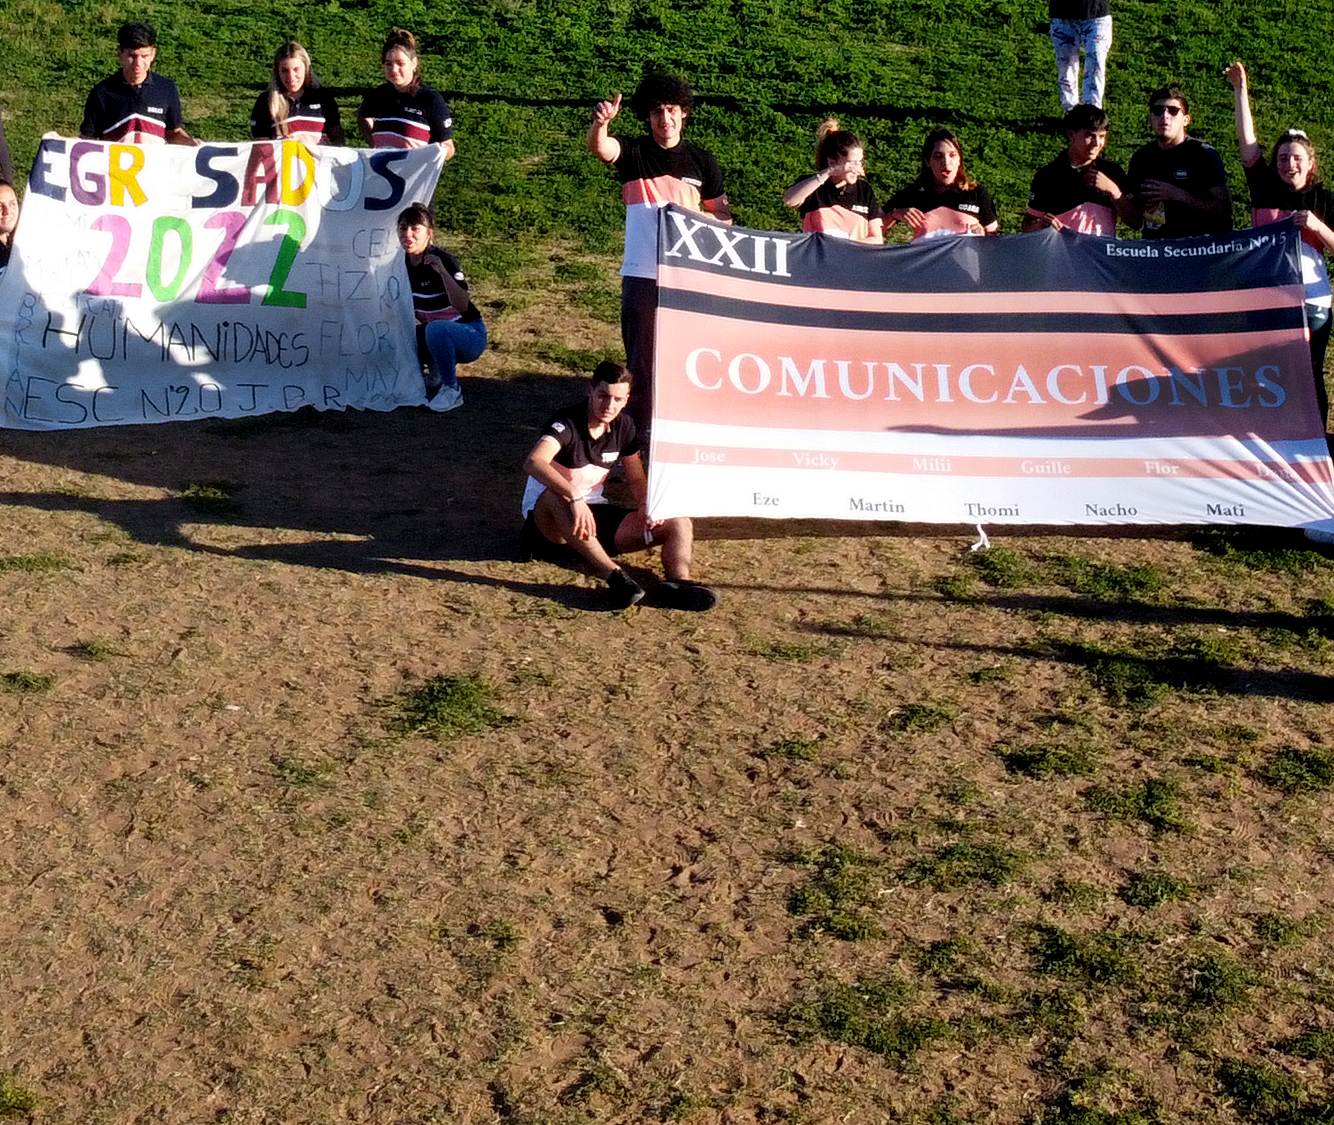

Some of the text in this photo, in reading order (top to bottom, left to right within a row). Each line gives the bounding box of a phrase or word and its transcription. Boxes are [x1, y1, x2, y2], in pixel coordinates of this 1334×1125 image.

[85, 208, 307, 309] 2022
[664, 210, 792, 278] XXII
[1105, 243, 1159, 258] Escuela
[1163, 241, 1243, 258] Secundaria
[321, 320, 396, 358] FLOR
[24, 376, 125, 424] ESC
[684, 347, 1286, 410] COMUNICACIONES
[692, 448, 725, 465] Jose
[793, 452, 841, 470] Vicky
[1020, 458, 1072, 477] Guille
[1144, 459, 1180, 477] Flor
[752, 492, 1246, 518] Eze Martin Thomi Nacho Mati
